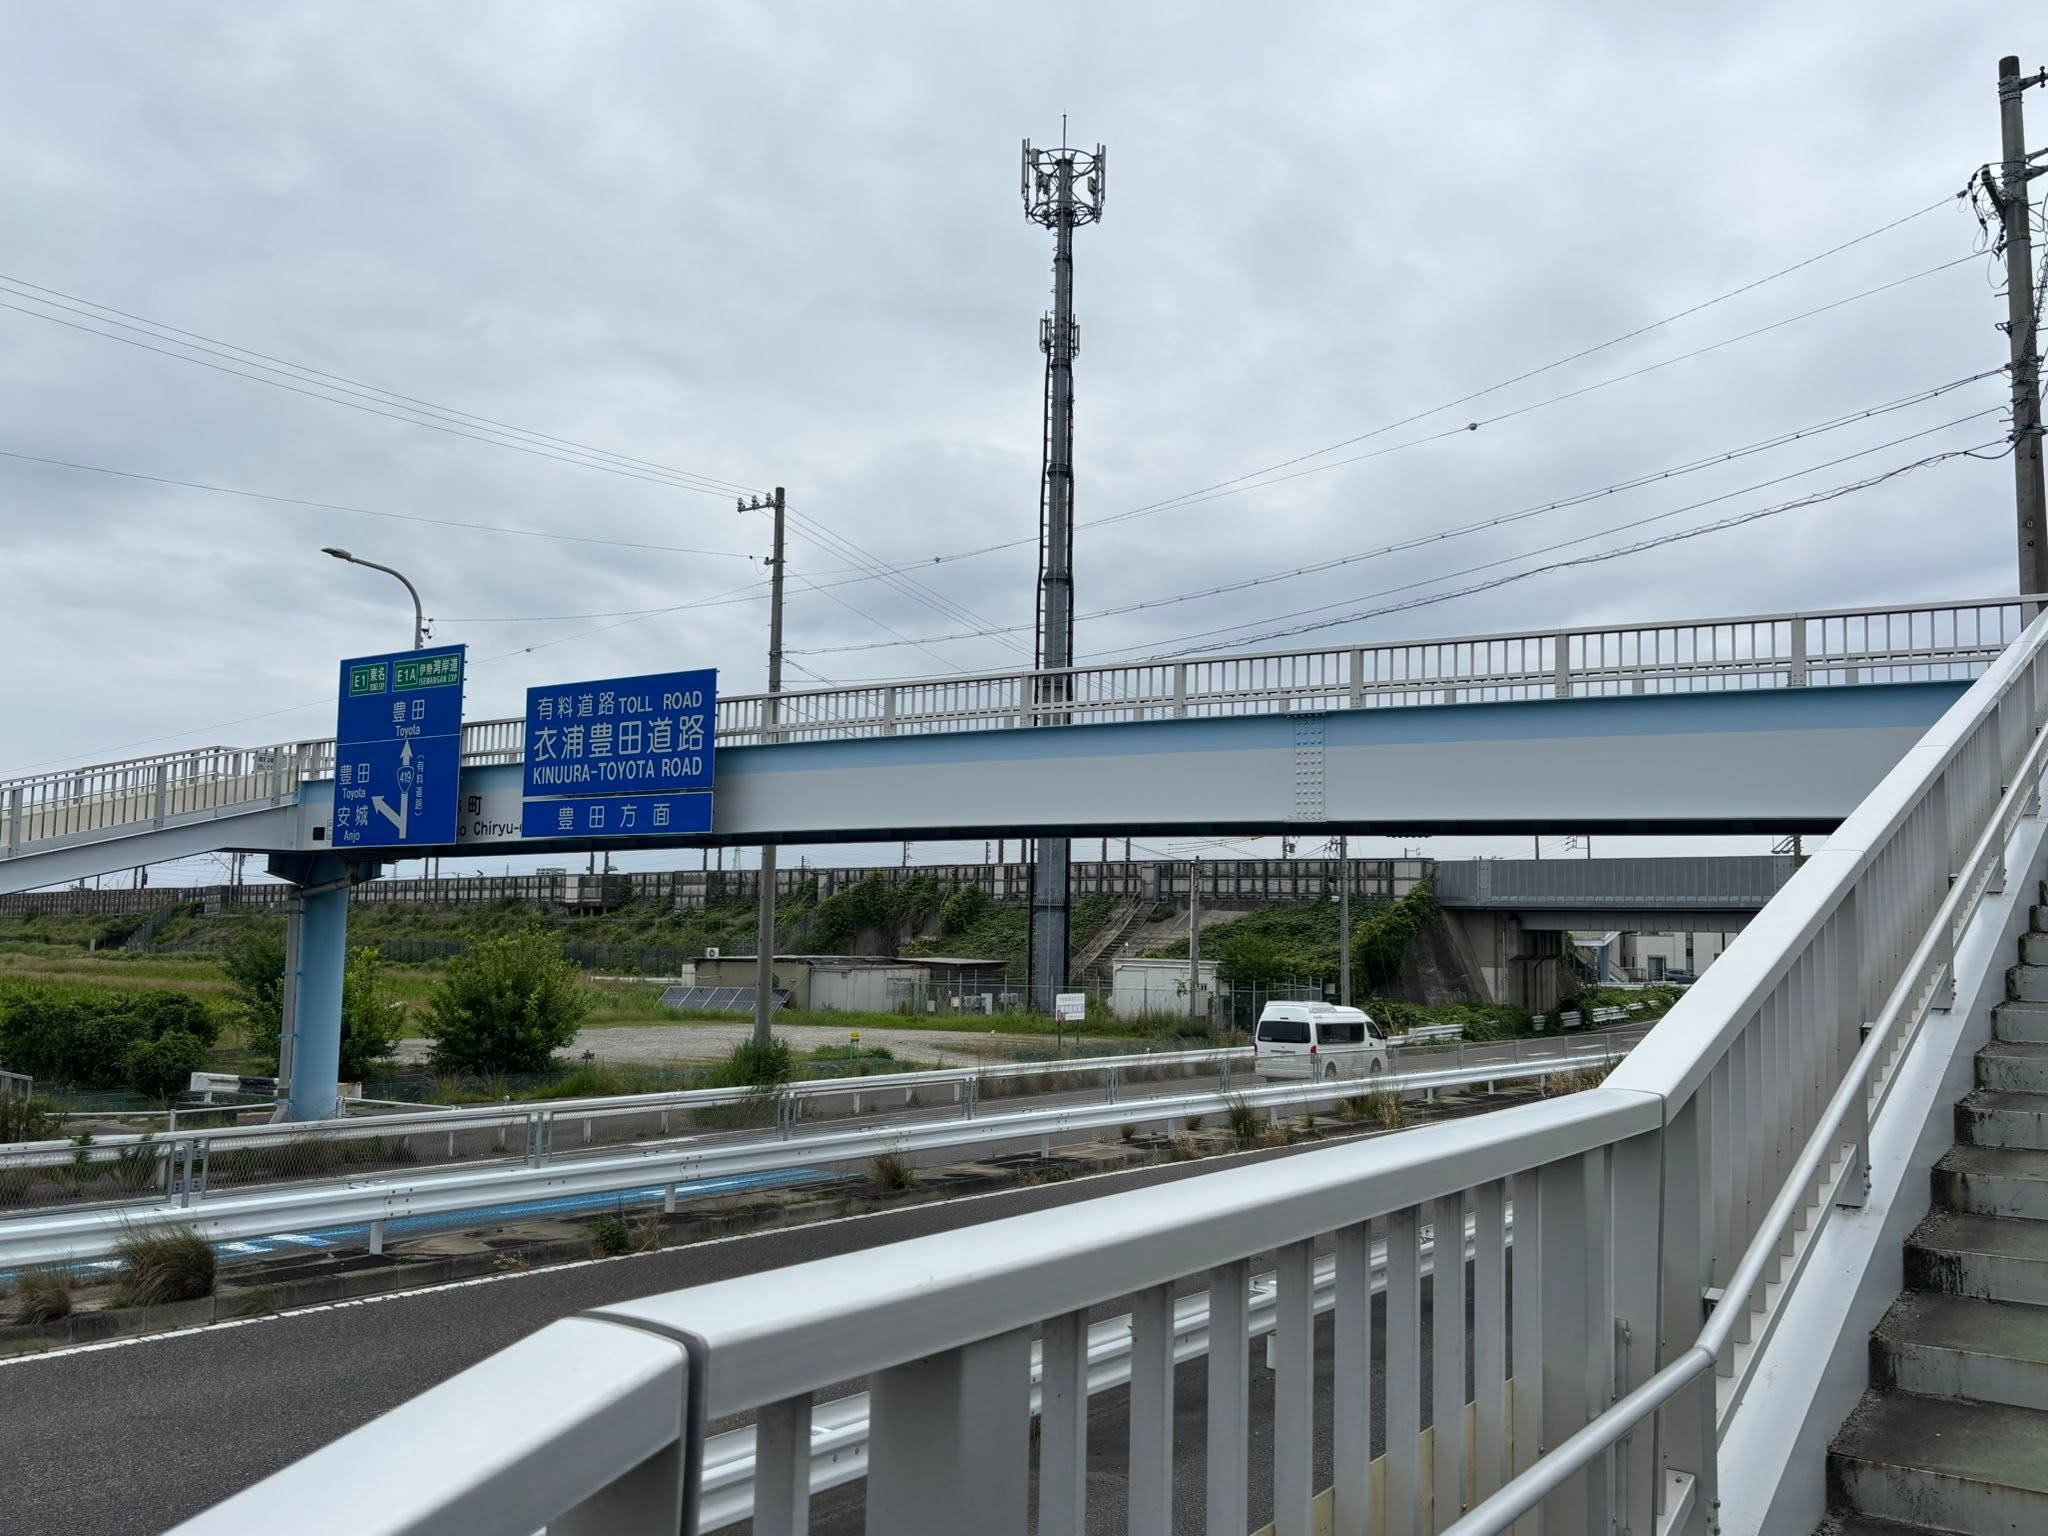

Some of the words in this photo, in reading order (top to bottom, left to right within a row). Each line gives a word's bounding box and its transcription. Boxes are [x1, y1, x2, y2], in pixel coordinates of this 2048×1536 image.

[354, 674, 366, 688] E1
[369, 667, 385, 681] 東名
[397, 668, 416, 683] E1A
[392, 699, 425, 723] 豊田
[537, 692, 615, 721] 有料道路
[618, 696, 653, 714] TOLL
[663, 690, 702, 710] ROAD
[395, 724, 421, 737] Toyota
[533, 715, 705, 762] 衣浦豊田道路
[339, 763, 370, 785] 豊田
[399, 770, 411, 784] 419
[533, 760, 655, 785] KINUURA-TOYOTA
[661, 756, 702, 777] ROAD
[342, 787, 366, 800] Toyota
[337, 804, 369, 827] 安城
[557, 803, 671, 830] 豊田方面
[343, 829, 361, 843] Anjo
[474, 821, 522, 837] Chiryu-
